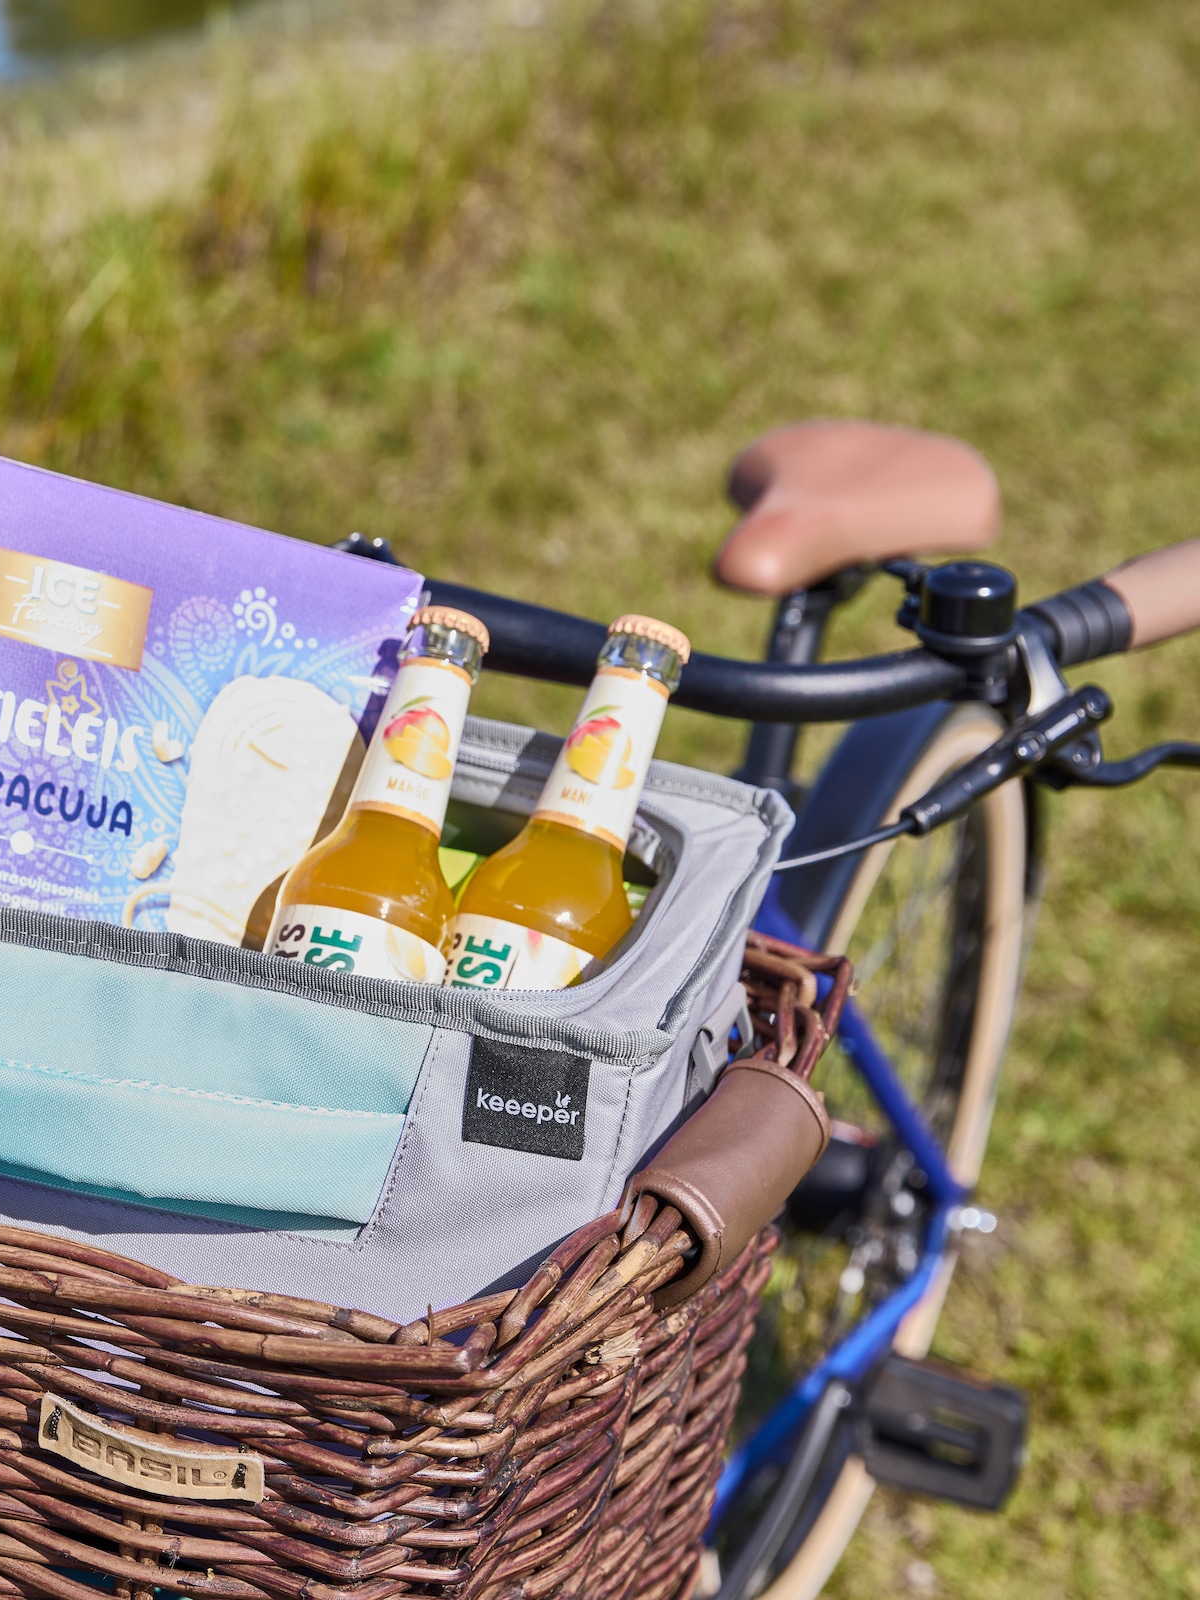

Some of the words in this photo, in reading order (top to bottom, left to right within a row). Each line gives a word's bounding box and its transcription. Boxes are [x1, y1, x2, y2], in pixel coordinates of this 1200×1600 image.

[29, 565, 100, 615] ICE
[12, 592, 103, 645] Fantasy
[385, 776, 430, 801] MANGO
[559, 785, 598, 808] MAN
[41, 902, 67, 918] mit
[476, 1087, 580, 1126] keeeper
[72, 1429, 226, 1487] BASIL
